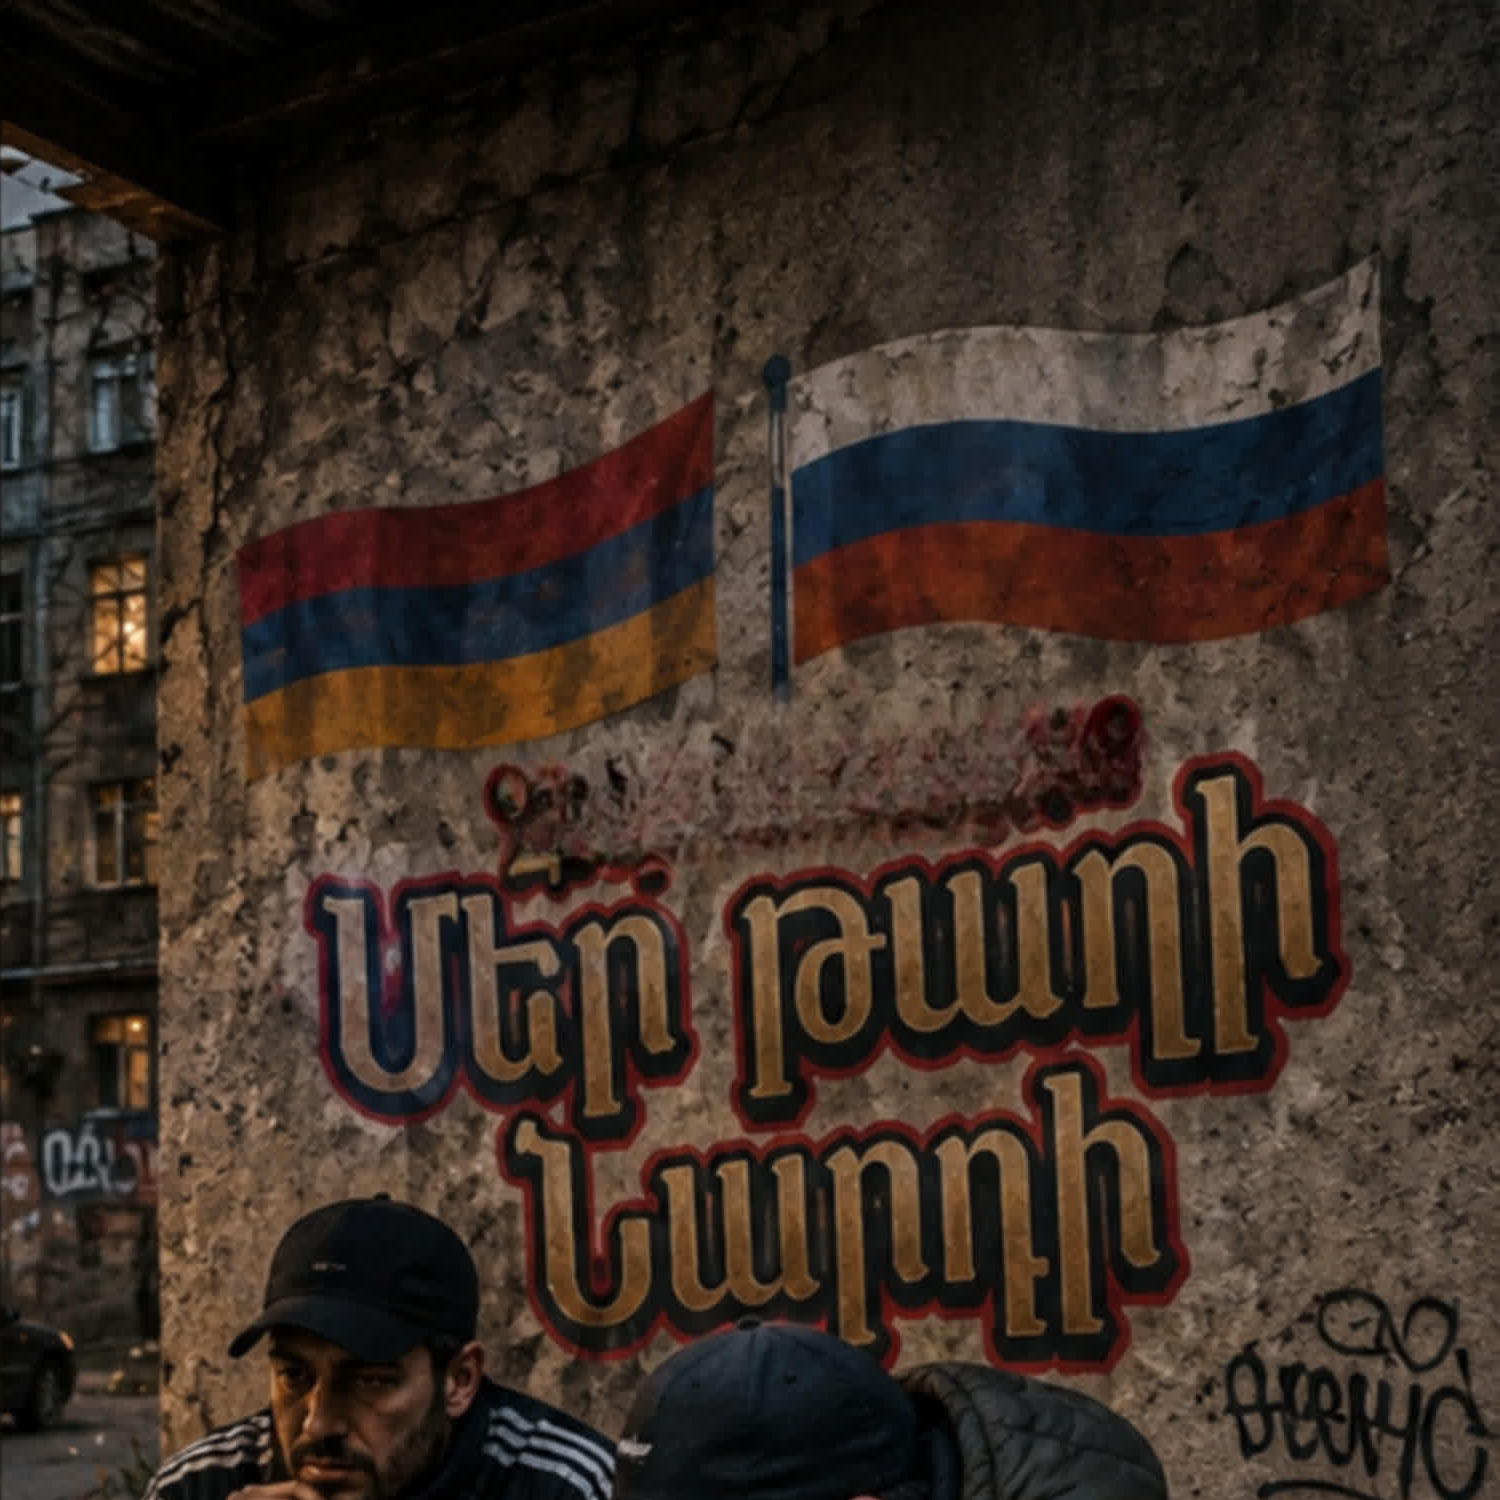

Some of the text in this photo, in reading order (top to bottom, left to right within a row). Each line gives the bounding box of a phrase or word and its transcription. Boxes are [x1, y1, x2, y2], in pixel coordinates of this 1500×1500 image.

[313, 882, 686, 1130] Մեր
[734, 764, 1336, 1110] թաղի
[508, 1063, 1172, 1354] Նարդի
